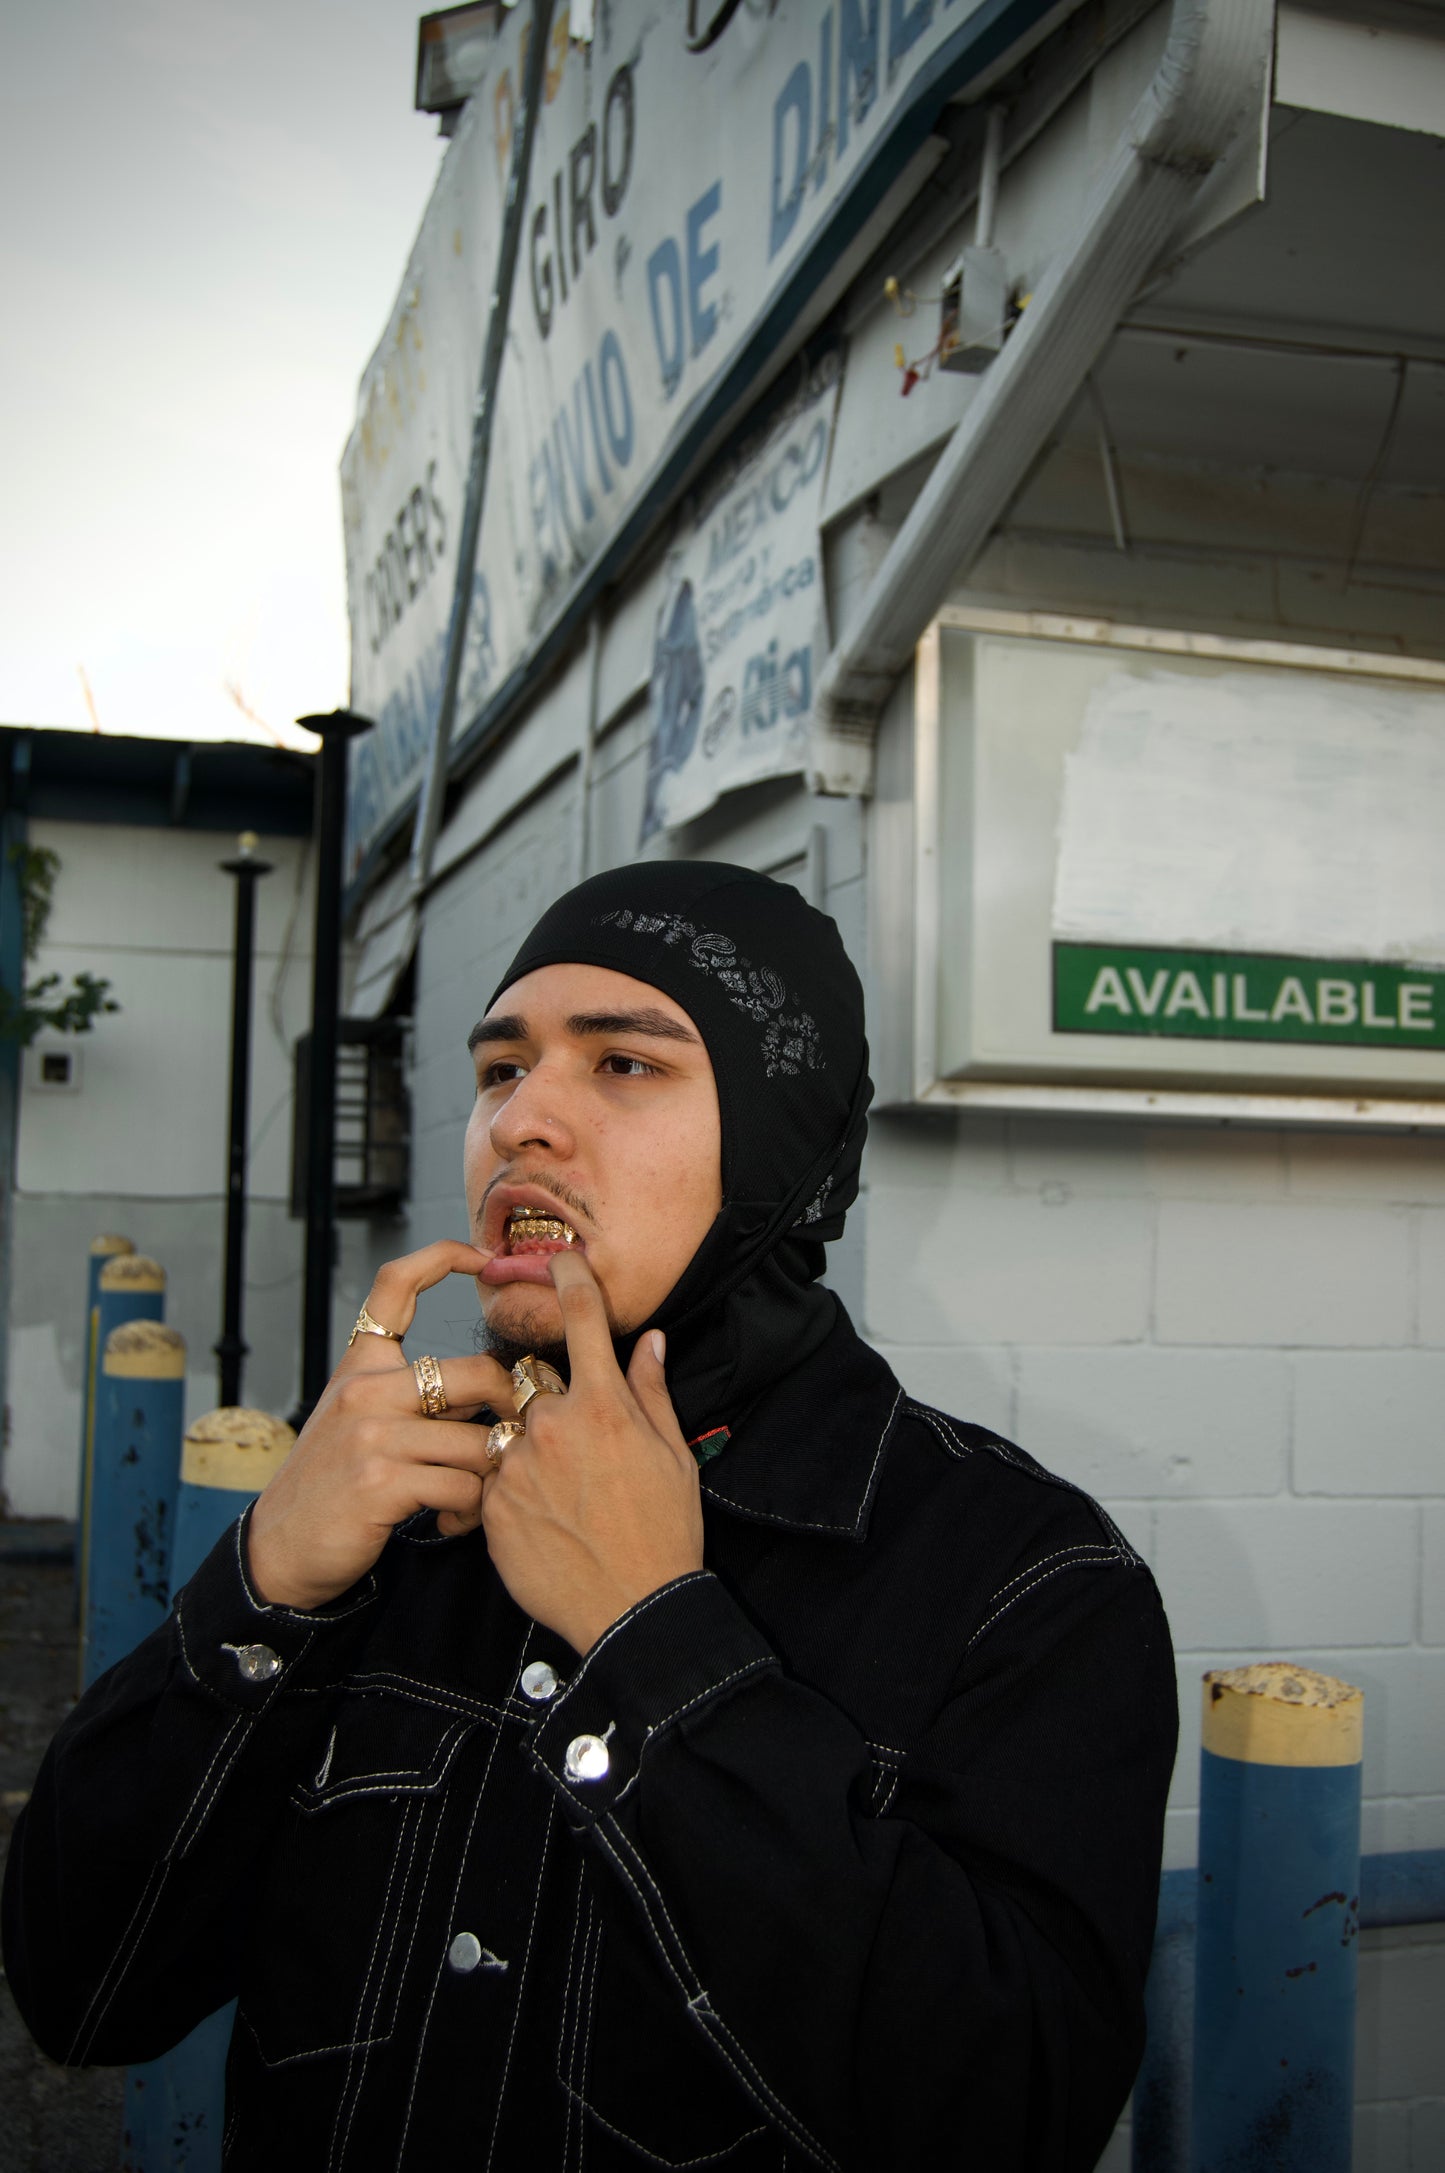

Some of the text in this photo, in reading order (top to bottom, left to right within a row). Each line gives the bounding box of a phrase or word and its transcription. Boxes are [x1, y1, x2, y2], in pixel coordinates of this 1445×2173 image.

[530, 62, 636, 342] GIRO
[646, 178, 722, 402] DE
[1084, 965, 1437, 1031] AVAILABLE
